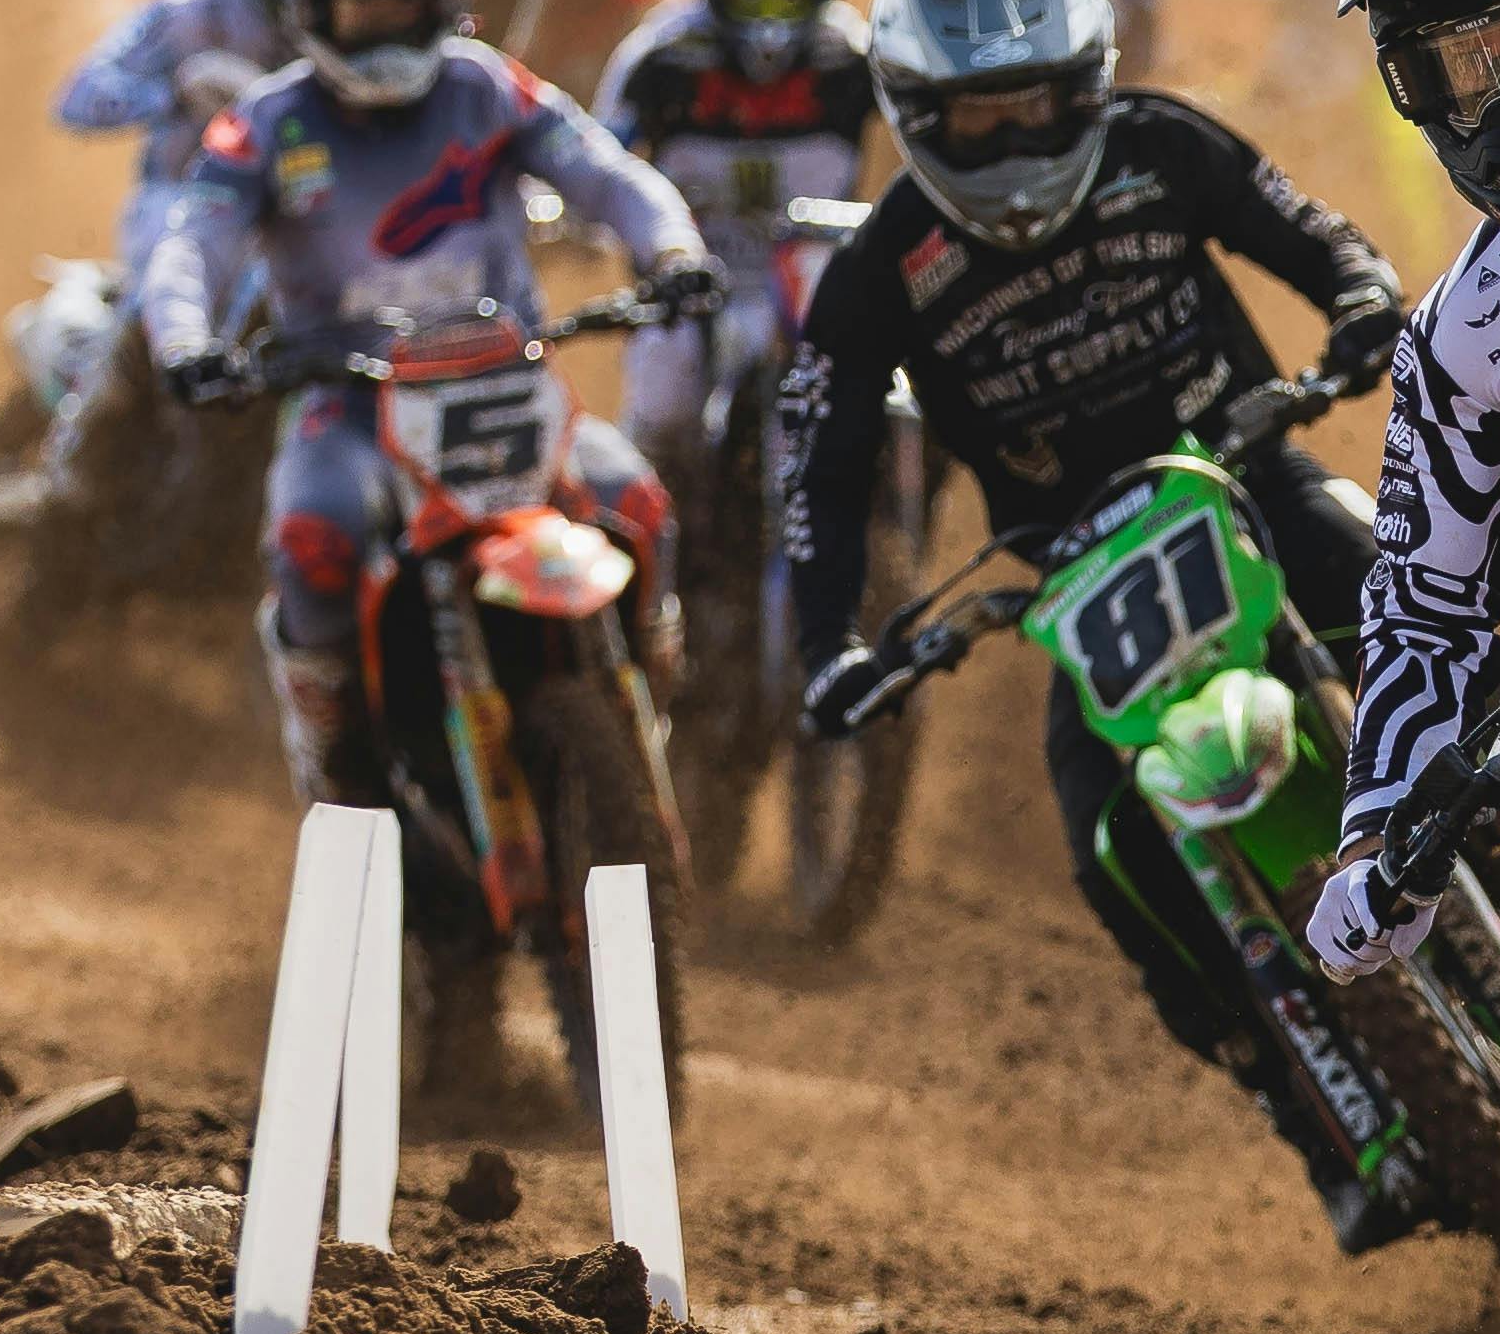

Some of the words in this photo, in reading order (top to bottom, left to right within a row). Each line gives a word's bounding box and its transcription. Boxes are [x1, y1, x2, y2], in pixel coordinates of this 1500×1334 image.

[1455, 17, 1490, 34] OAKLEY
[1386, 60, 1410, 107] OAKLEY
[440, 385, 540, 489] 5
[1385, 411, 1413, 453] HGS
[1382, 455, 1419, 476] DUNLOP
[1072, 524, 1235, 713] 81
